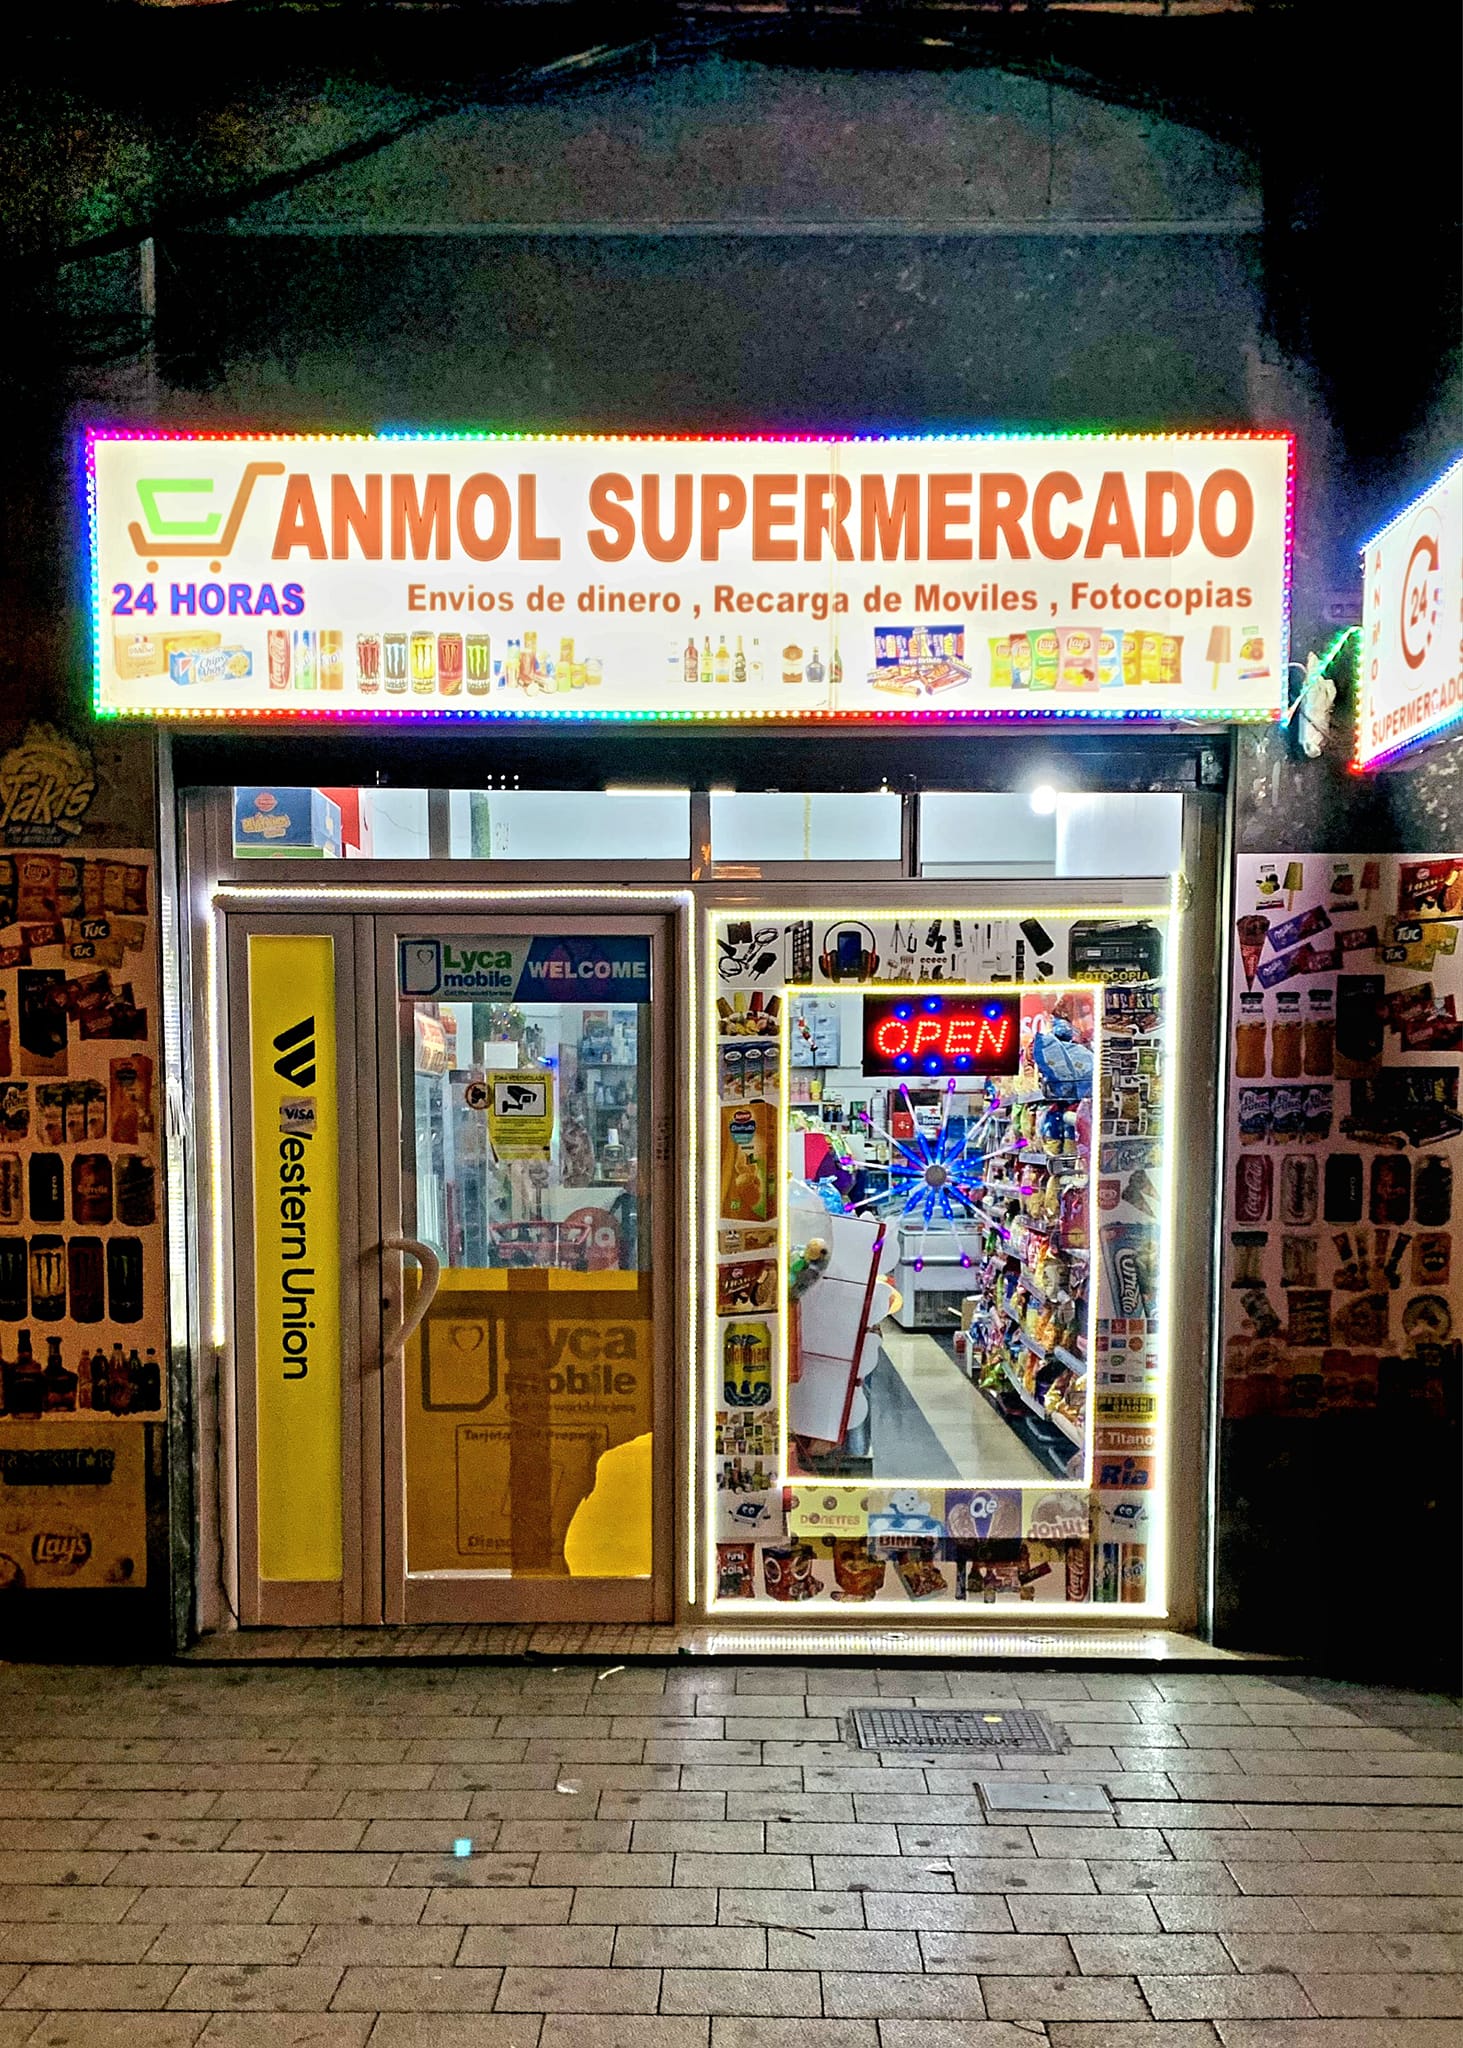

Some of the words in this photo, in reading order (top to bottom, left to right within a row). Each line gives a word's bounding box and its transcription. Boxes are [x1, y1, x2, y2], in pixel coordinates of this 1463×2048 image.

[271, 471, 561, 562] ANMOL
[586, 469, 1254, 562] SUPERMERCADO
[111, 583, 156, 616] 24
[169, 582, 306, 616] HORAS
[407, 584, 521, 613] Envios
[526, 584, 565, 613] de
[577, 584, 682, 613] dinero
[715, 584, 850, 614] Recarga
[863, 584, 902, 613] de
[913, 583, 1039, 613] Moviles
[1071, 581, 1254, 613] Fotocopias
[1409, 578, 1428, 628] 24
[443, 944, 512, 973] Lyca
[527, 961, 647, 979] WELCOME
[443, 971, 512, 987] mobile
[878, 1019, 1009, 1054] OPEN
[280, 1107, 315, 1261] estern
[280, 1268, 315, 1380] Union
[1100, 1457, 1149, 1486] Ria
